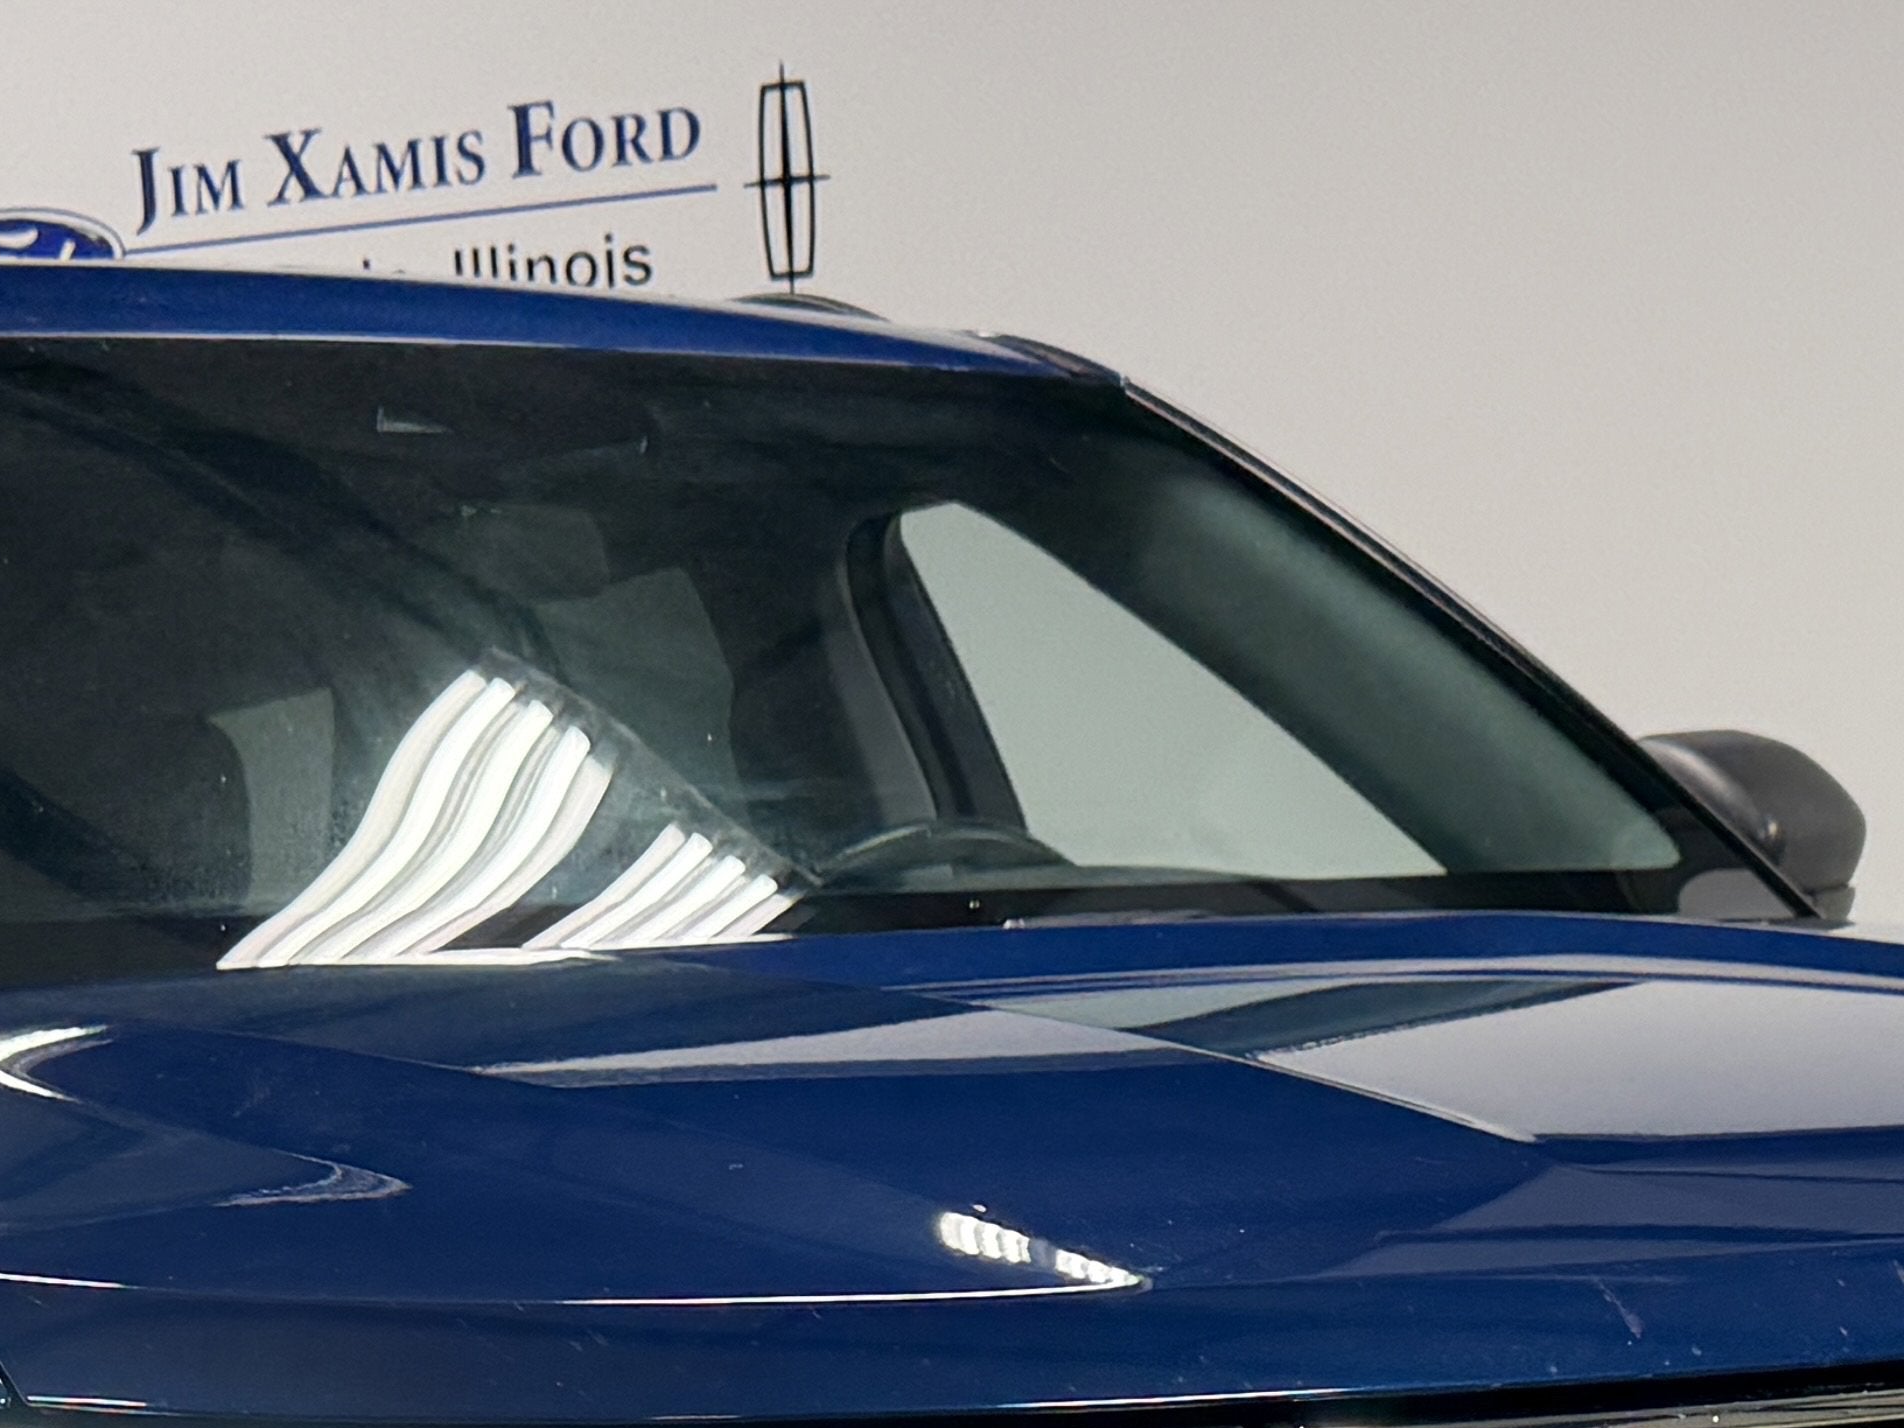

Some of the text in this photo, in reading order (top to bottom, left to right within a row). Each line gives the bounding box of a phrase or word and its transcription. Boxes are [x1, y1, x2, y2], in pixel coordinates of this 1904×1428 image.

[131, 100, 702, 236] JIM XAMIS FORD
